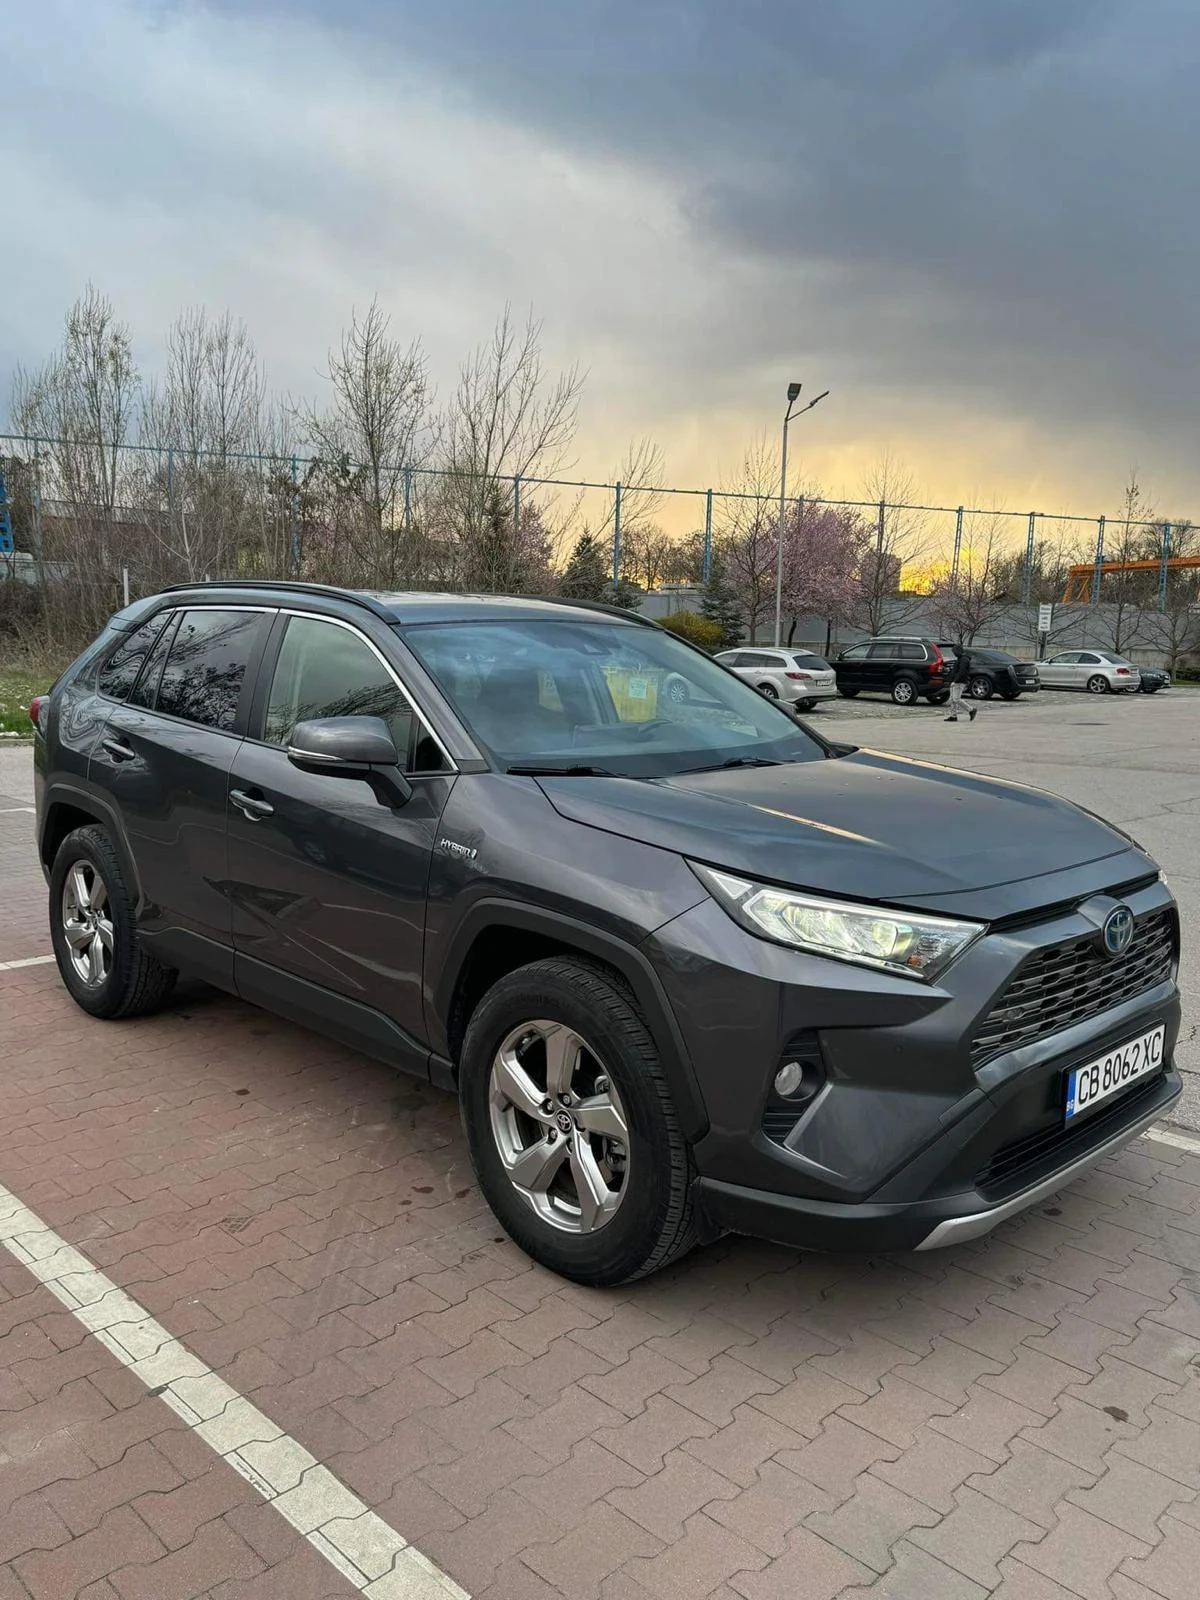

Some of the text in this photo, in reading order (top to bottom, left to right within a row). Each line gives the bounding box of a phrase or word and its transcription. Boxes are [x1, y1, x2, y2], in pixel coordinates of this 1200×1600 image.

[1078, 1031, 1162, 1104] CB 8062 XC
